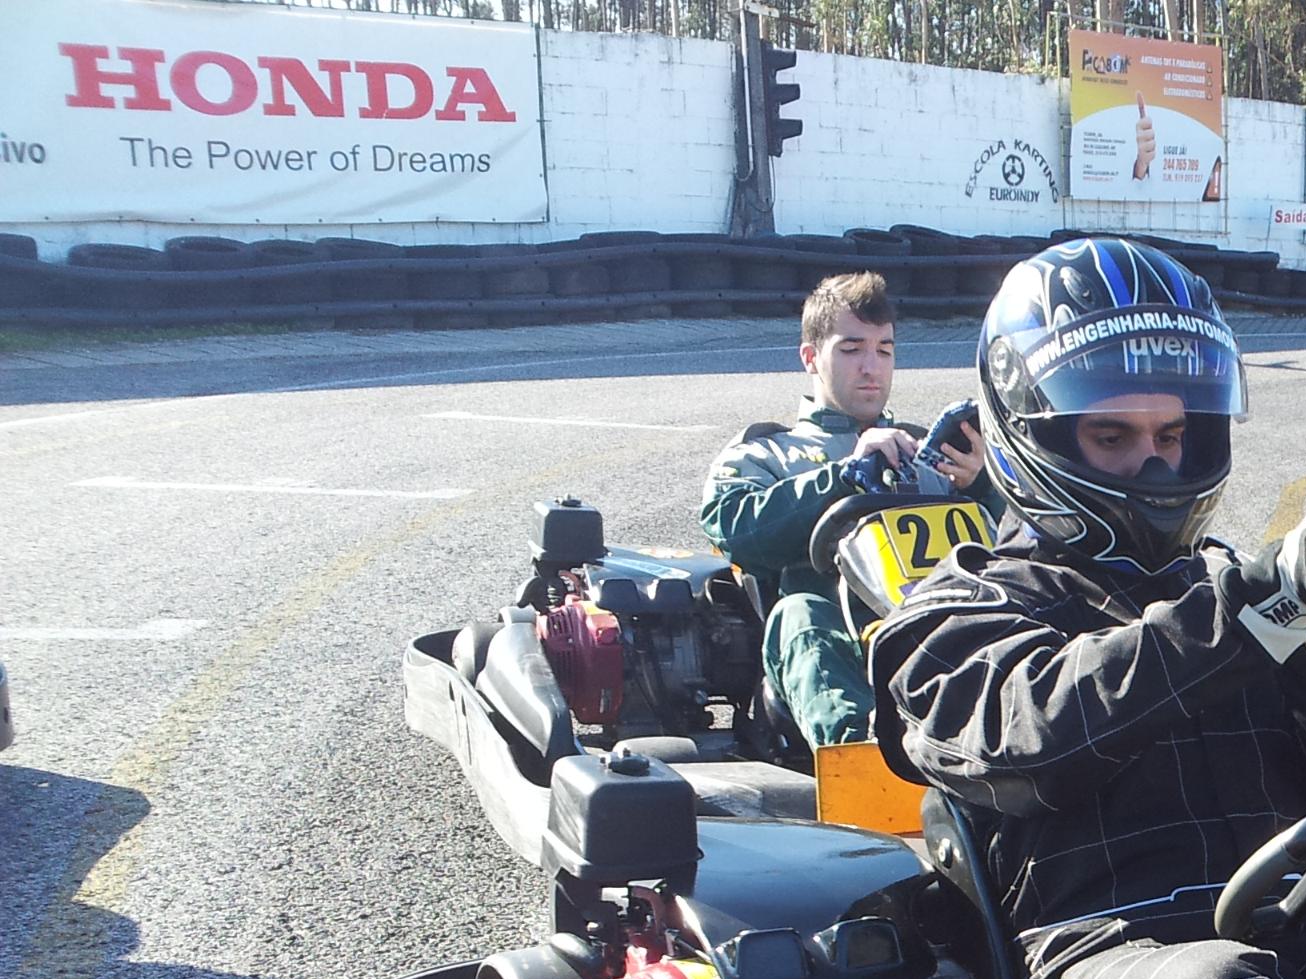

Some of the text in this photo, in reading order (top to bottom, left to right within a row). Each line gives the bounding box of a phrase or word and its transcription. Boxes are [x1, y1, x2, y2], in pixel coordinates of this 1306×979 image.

[58, 42, 517, 123] HONDA
[0, 132, 491, 174] ivo The Power of Dreams
[965, 140, 1006, 198] ESCOLA
[1014, 138, 1059, 204] KARTING
[988, 186, 1040, 203] EUROINDY
[1129, 337, 1197, 358] uvex
[896, 507, 984, 569] 20
